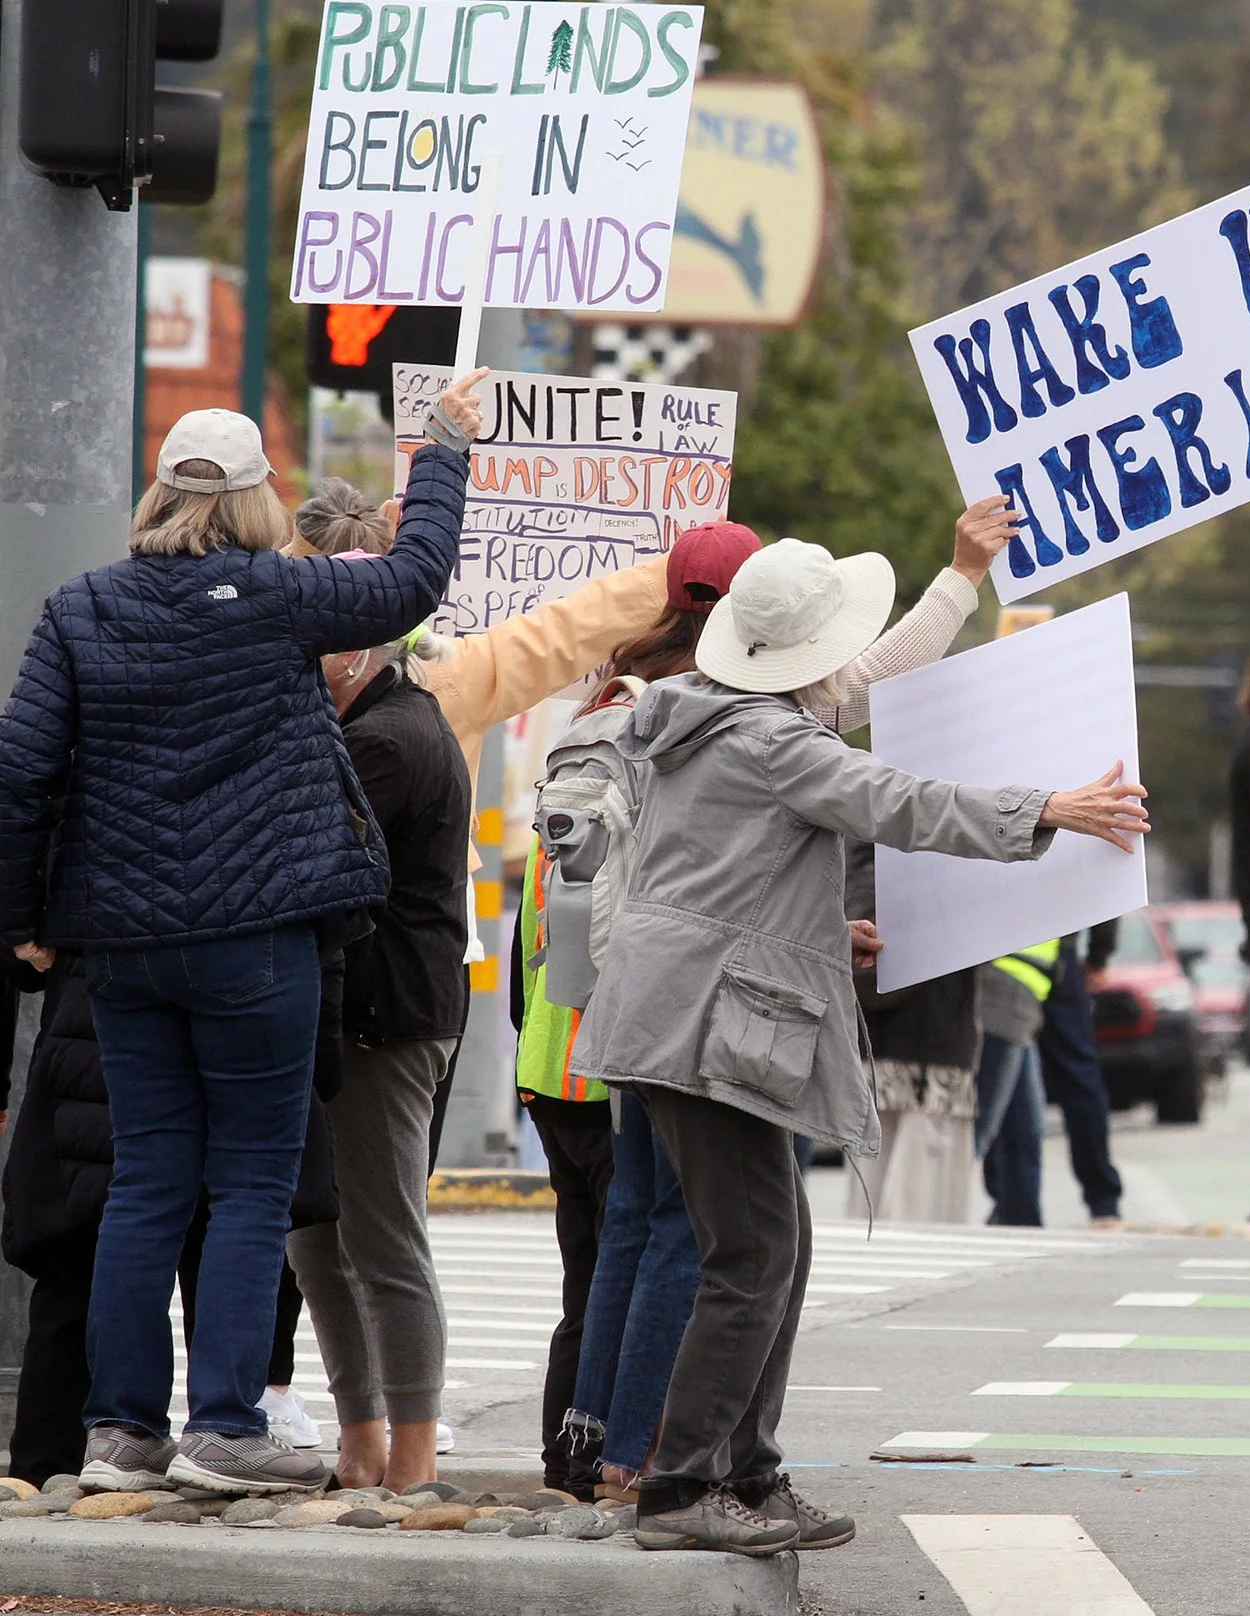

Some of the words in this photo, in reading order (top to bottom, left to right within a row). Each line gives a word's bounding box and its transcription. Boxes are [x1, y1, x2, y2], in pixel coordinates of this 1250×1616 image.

[318, 110, 487, 193] BELONG
[531, 114, 589, 196] IN
[694, 108, 798, 172] NER
[484, 214, 671, 305] HANDS
[933, 252, 1183, 444] WAKE
[395, 369, 452, 396] SOCIA
[475, 381, 646, 444] UNITE!
[661, 394, 723, 428] RULE
[659, 431, 718, 454] LAW
[397, 442, 559, 498] TUMP
[574, 455, 732, 510] DESTROY
[460, 507, 590, 532] STITUTION
[453, 590, 566, 629] SPEE
